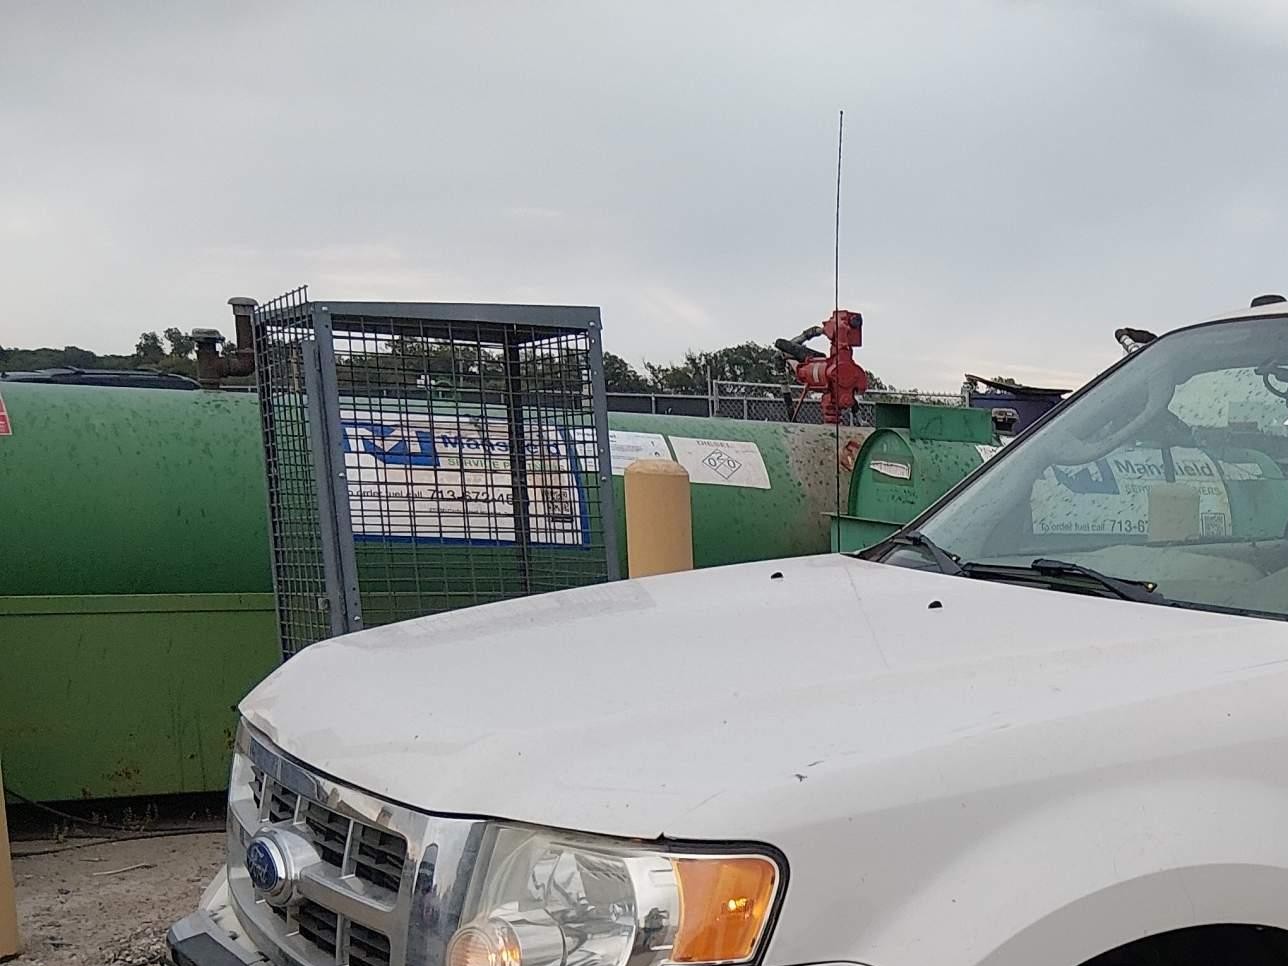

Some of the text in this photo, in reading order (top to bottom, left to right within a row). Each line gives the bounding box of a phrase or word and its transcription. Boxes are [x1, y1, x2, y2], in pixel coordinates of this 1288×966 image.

[440, 434, 560, 456] Mansed
[448, 458, 498, 469] SRVIE
[1114, 459, 1214, 477] Manield
[427, 489, 529, 505] 713-672-45
[1110, 519, 1148, 533] 713-6
